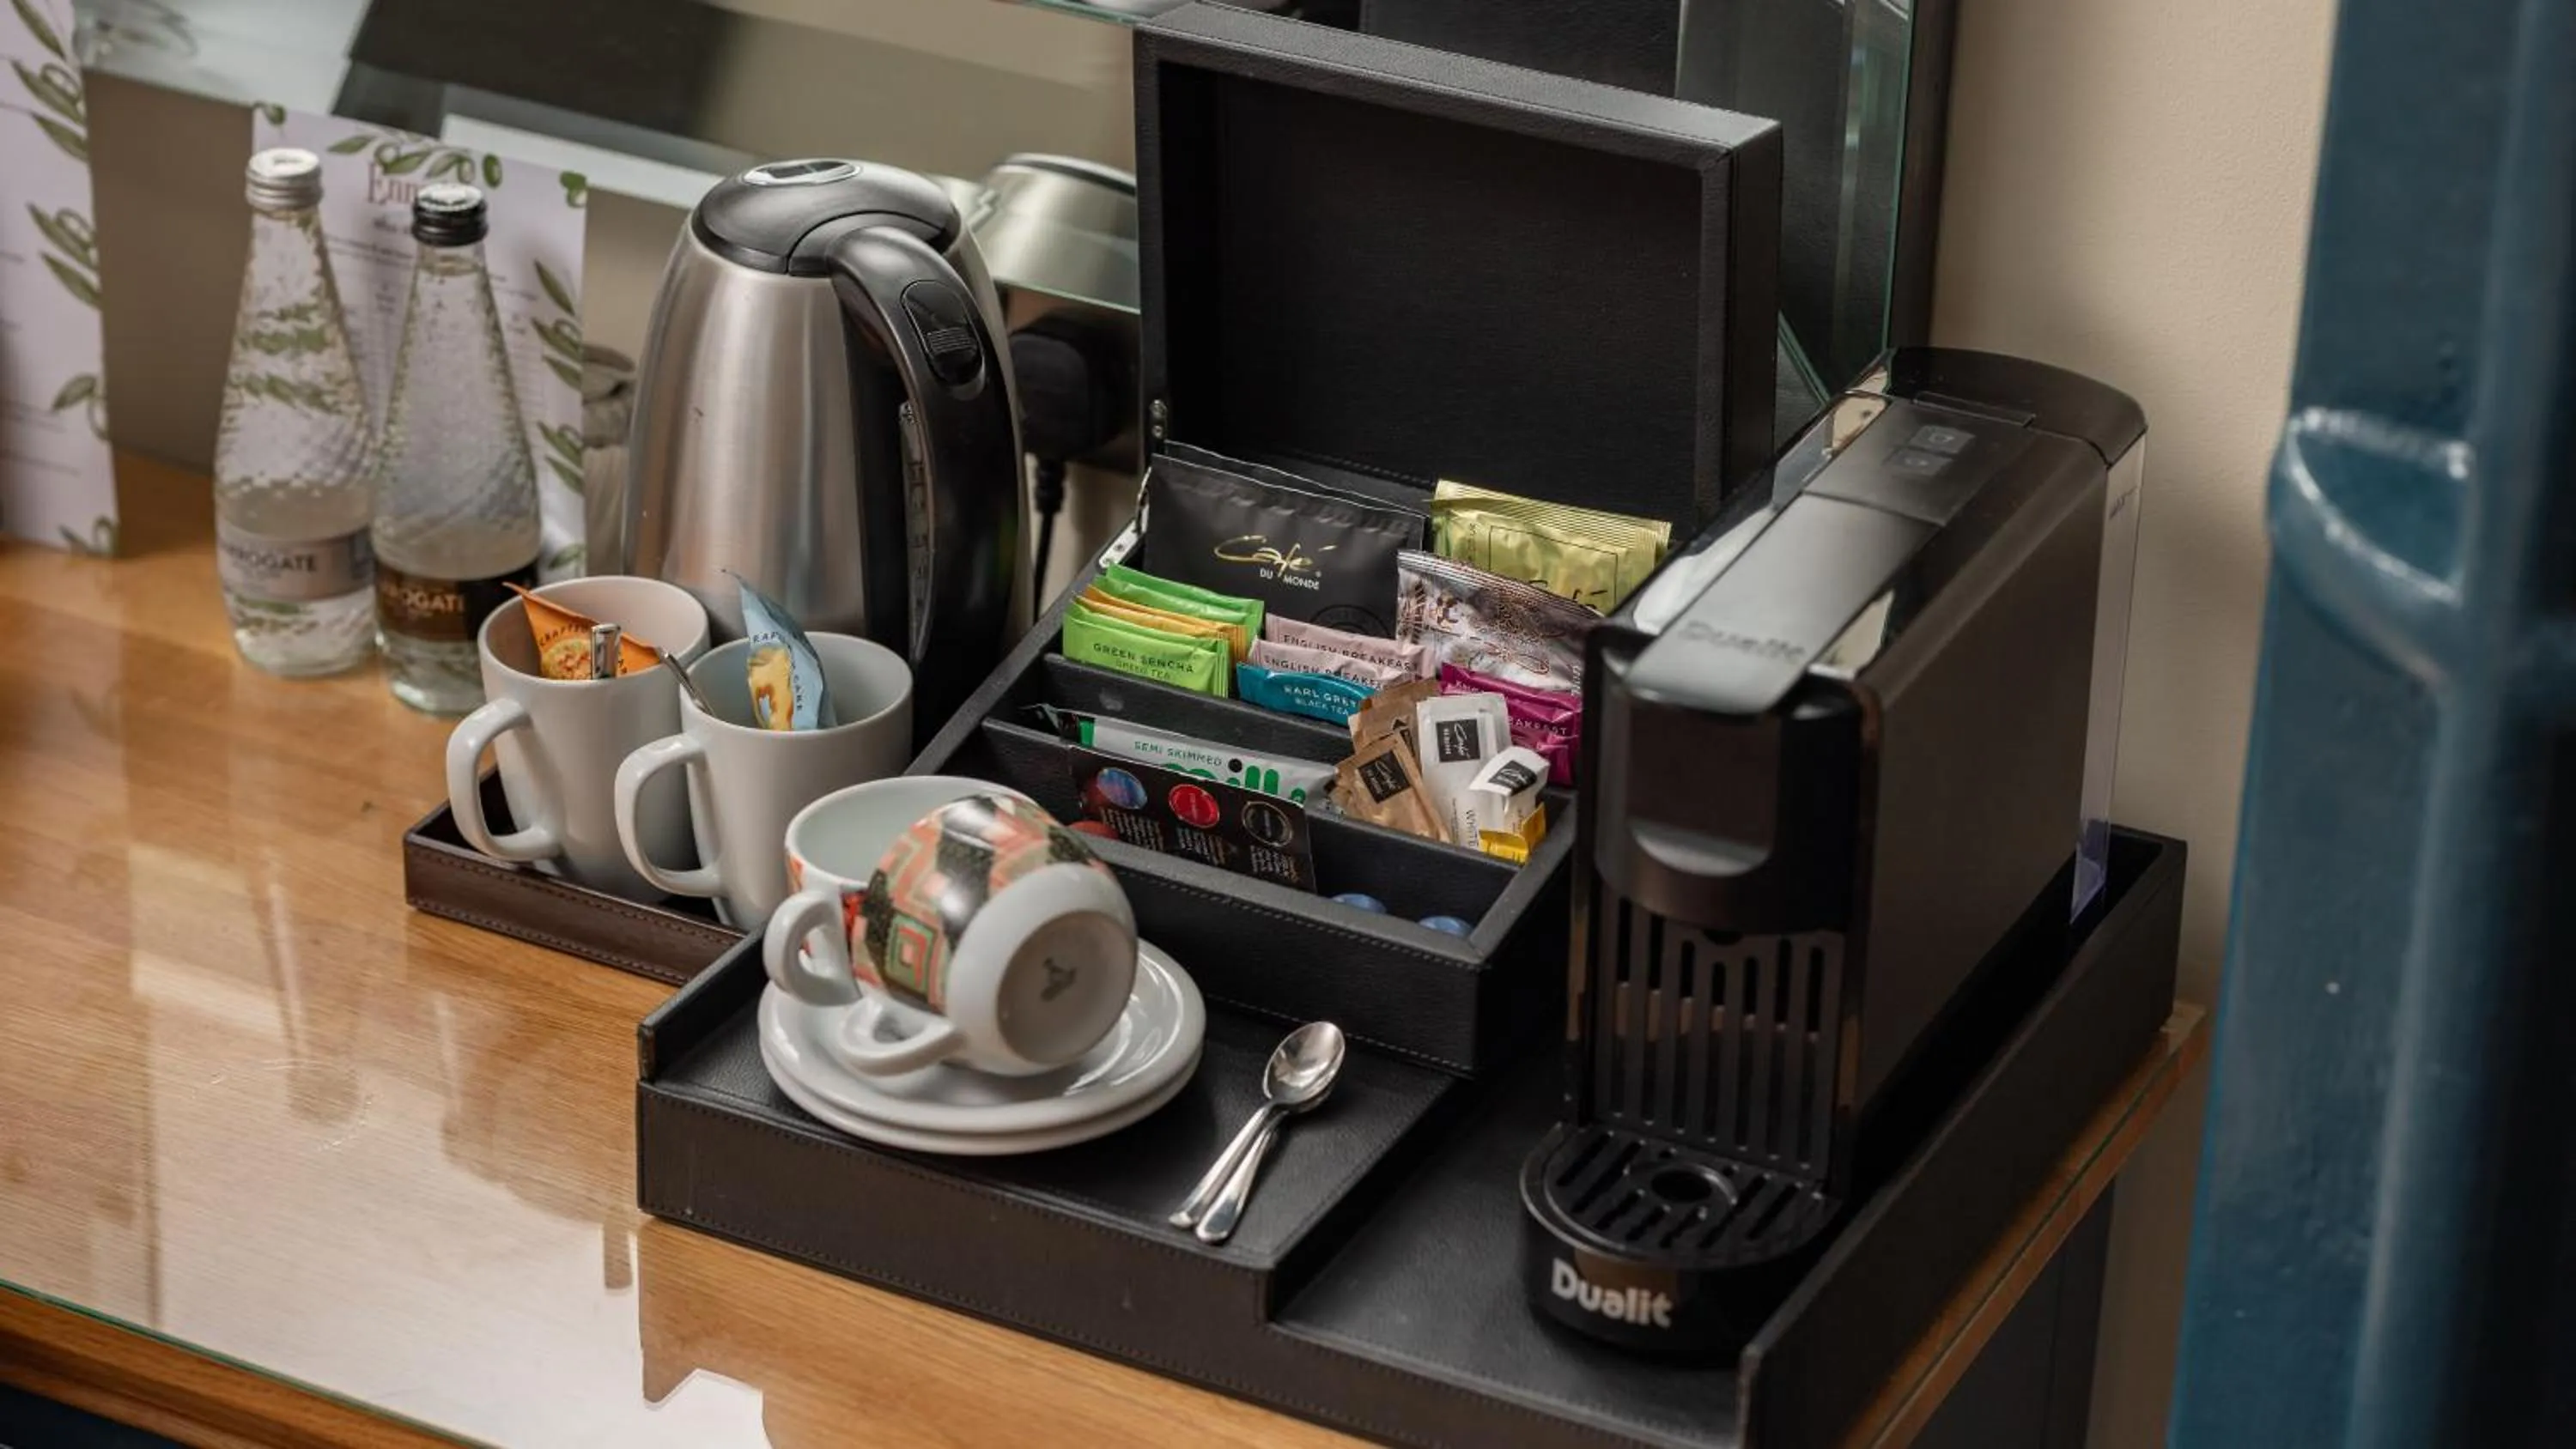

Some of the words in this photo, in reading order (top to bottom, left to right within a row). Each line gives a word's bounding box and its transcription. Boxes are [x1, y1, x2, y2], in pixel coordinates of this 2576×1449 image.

[1260, 567, 1273, 579] DU
[1283, 573, 1320, 591] MONDE
[1093, 643, 1135, 660] GREEN
[1140, 656, 1194, 673] SENCHA
[1134, 741, 1162, 755] SEMI
[1167, 748, 1223, 767] SKIMMED
[1552, 1258, 1673, 1328] Dualit
